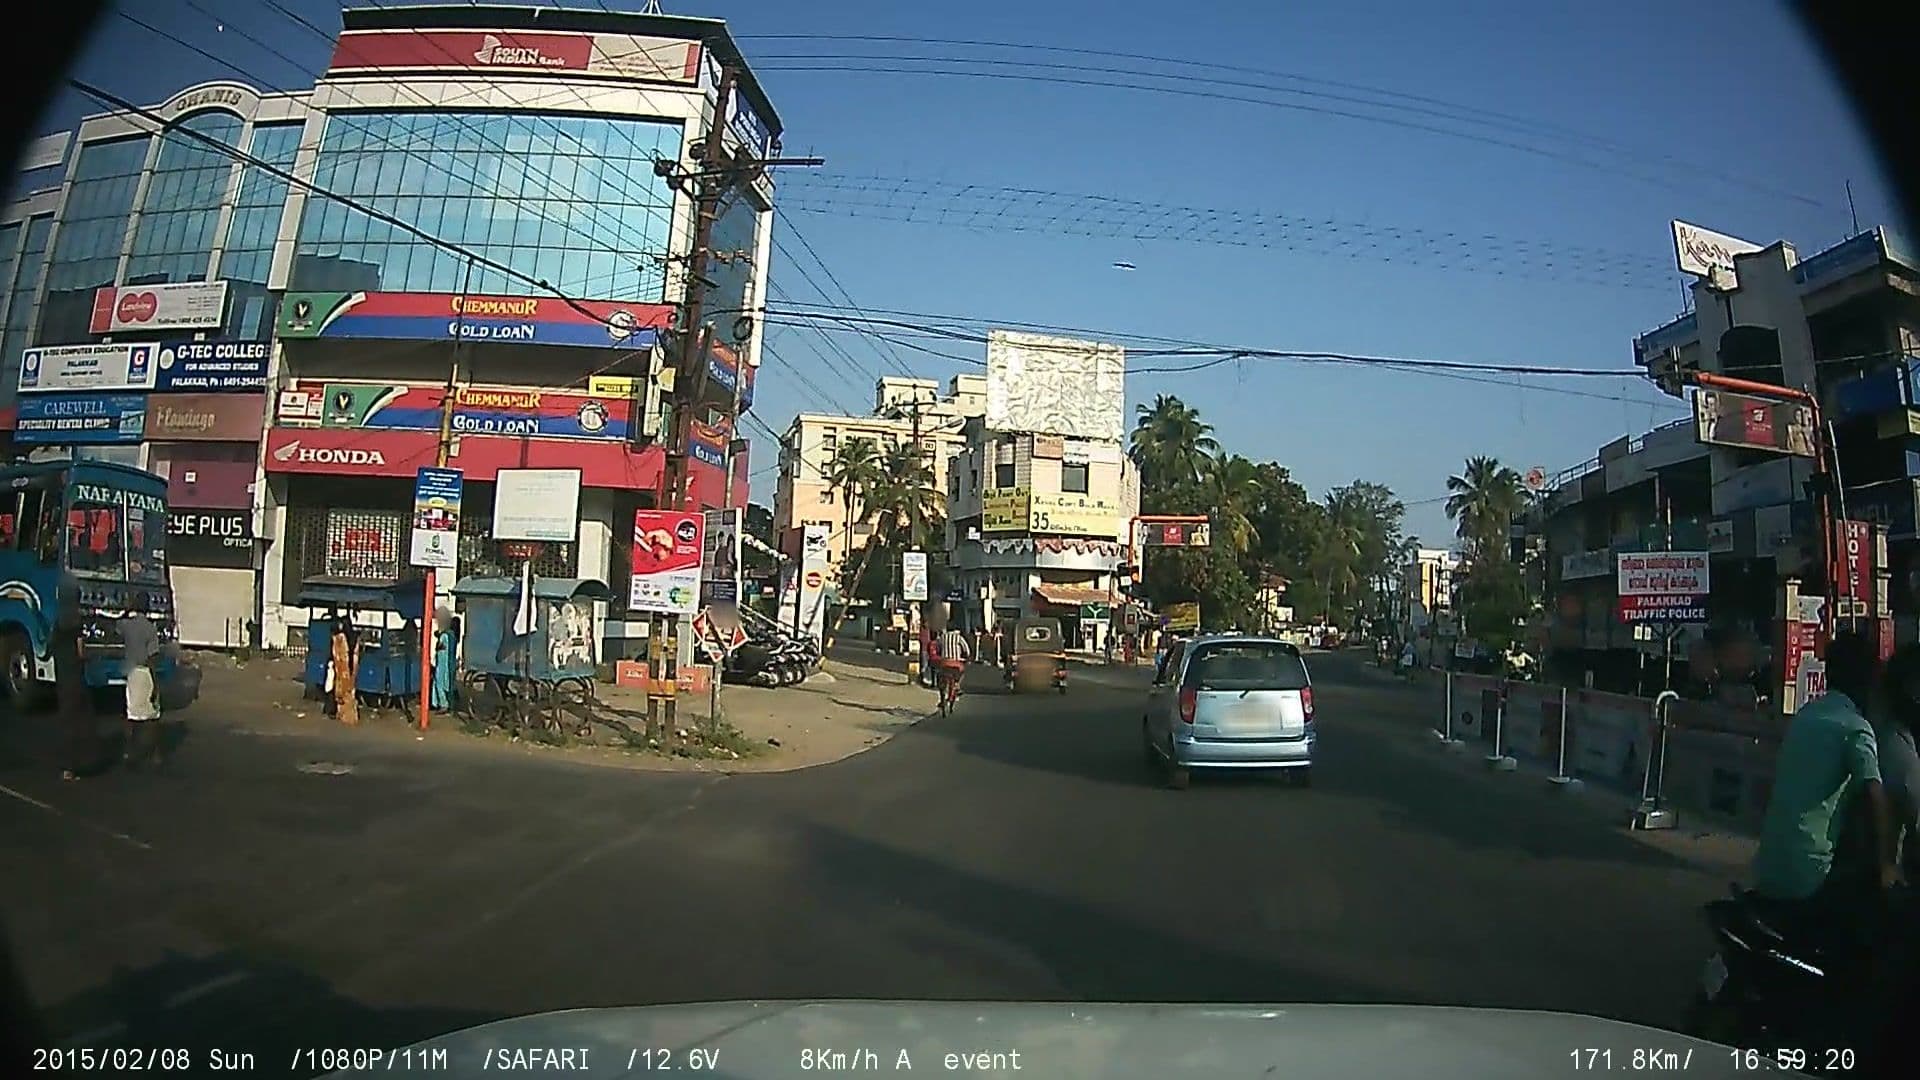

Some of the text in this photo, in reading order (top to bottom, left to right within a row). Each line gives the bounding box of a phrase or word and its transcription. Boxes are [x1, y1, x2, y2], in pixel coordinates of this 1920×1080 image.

[493, 54, 565, 66] INDIAN Bank
[494, 47, 539, 57] SOUTH
[449, 322, 536, 339] GOLD LOAN
[94, 345, 129, 355] EDUCATION
[177, 344, 213, 359] G-TEC
[455, 388, 541, 408] CHEMMANUR
[44, 400, 107, 415] CAREWELL
[84, 418, 110, 429] CLINIC
[453, 414, 540, 433] GOLD LOAN
[299, 448, 386, 465] HONDA
[200, 515, 243, 536] PLUS
[1032, 511, 1050, 531] 35
[1847, 523, 1860, 601] HOTEL
[1623, 607, 1706, 620] TRAFFIC POLICE
